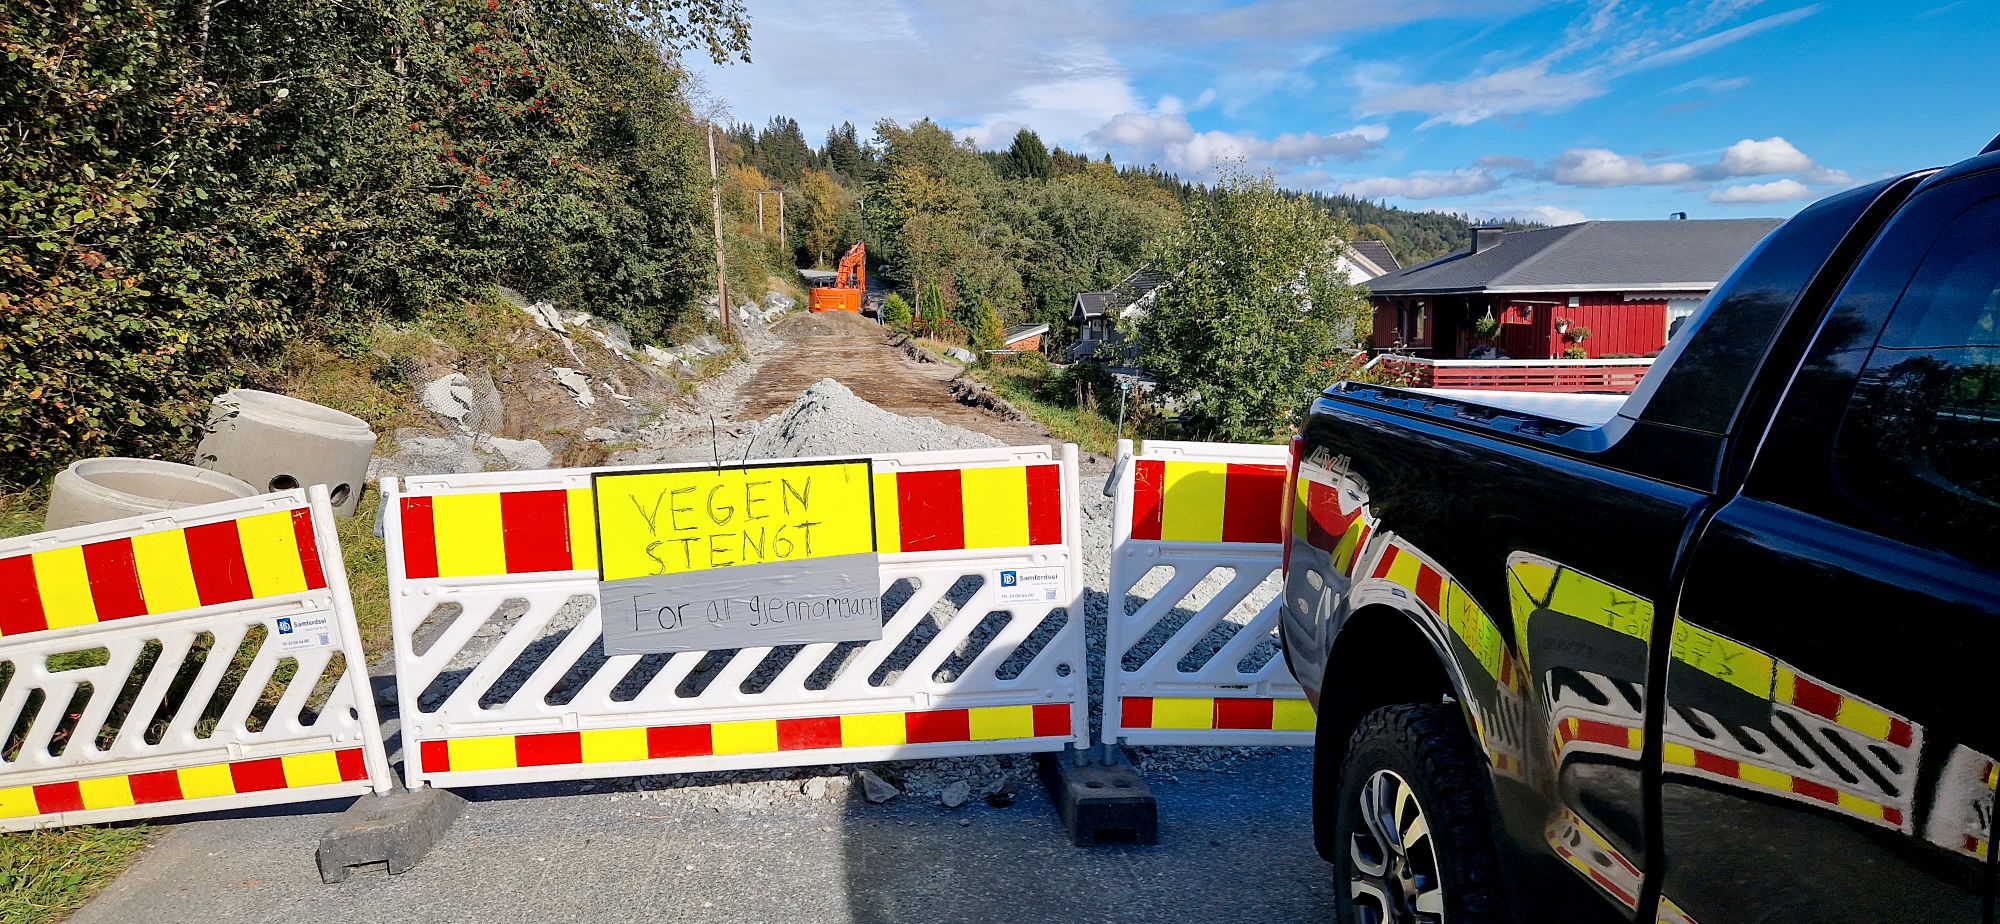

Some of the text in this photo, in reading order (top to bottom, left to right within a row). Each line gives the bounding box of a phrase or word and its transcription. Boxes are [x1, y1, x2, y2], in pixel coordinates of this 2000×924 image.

[630, 476, 811, 536] VEGEN
[645, 521, 822, 576] STENGT
[634, 592, 690, 631] For
[706, 597, 731, 623] all
